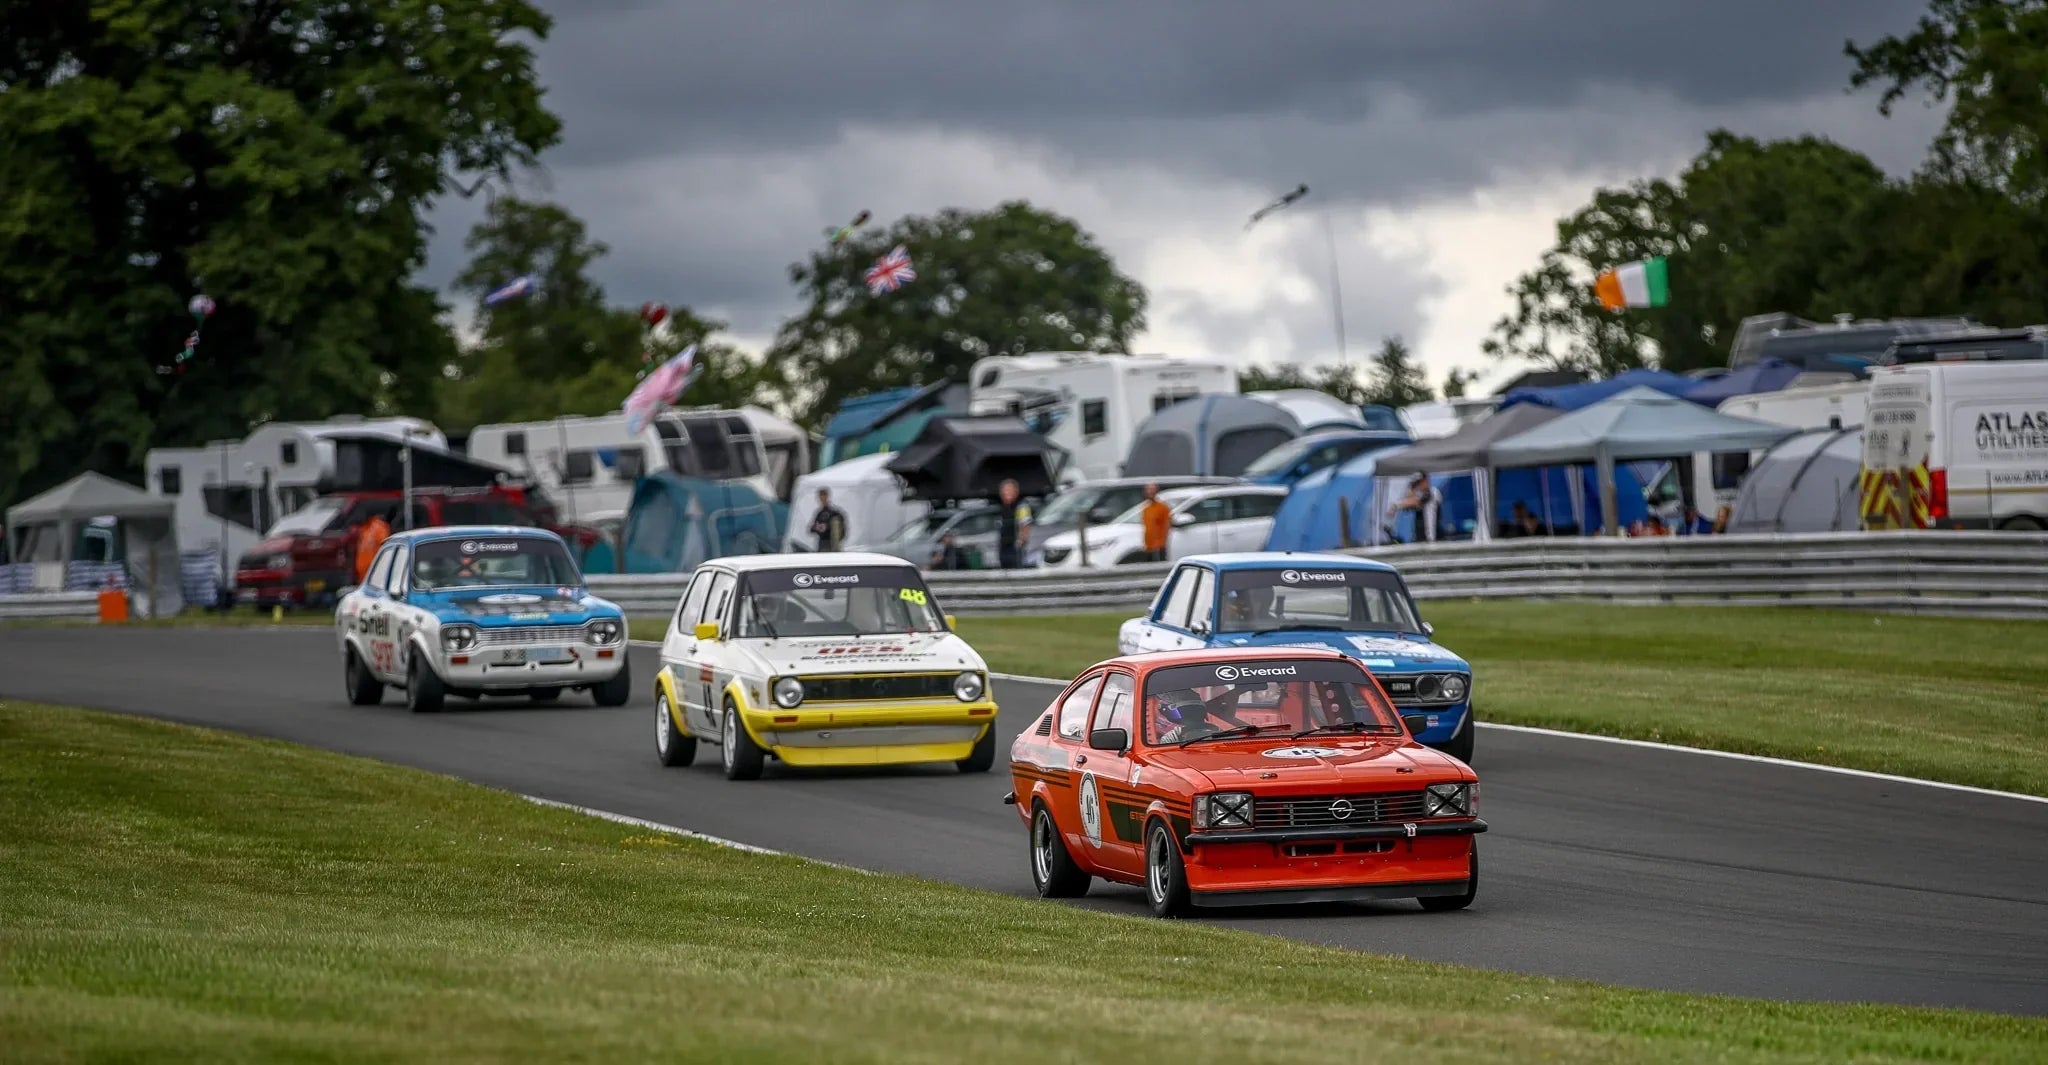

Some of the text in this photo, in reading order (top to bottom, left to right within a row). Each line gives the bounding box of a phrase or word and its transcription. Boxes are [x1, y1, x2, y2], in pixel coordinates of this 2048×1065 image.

[1976, 411, 2048, 431] ATLAS
[813, 574, 860, 584] Everard
[1301, 571, 1346, 581] Everard
[1240, 666, 1297, 677] Everard
